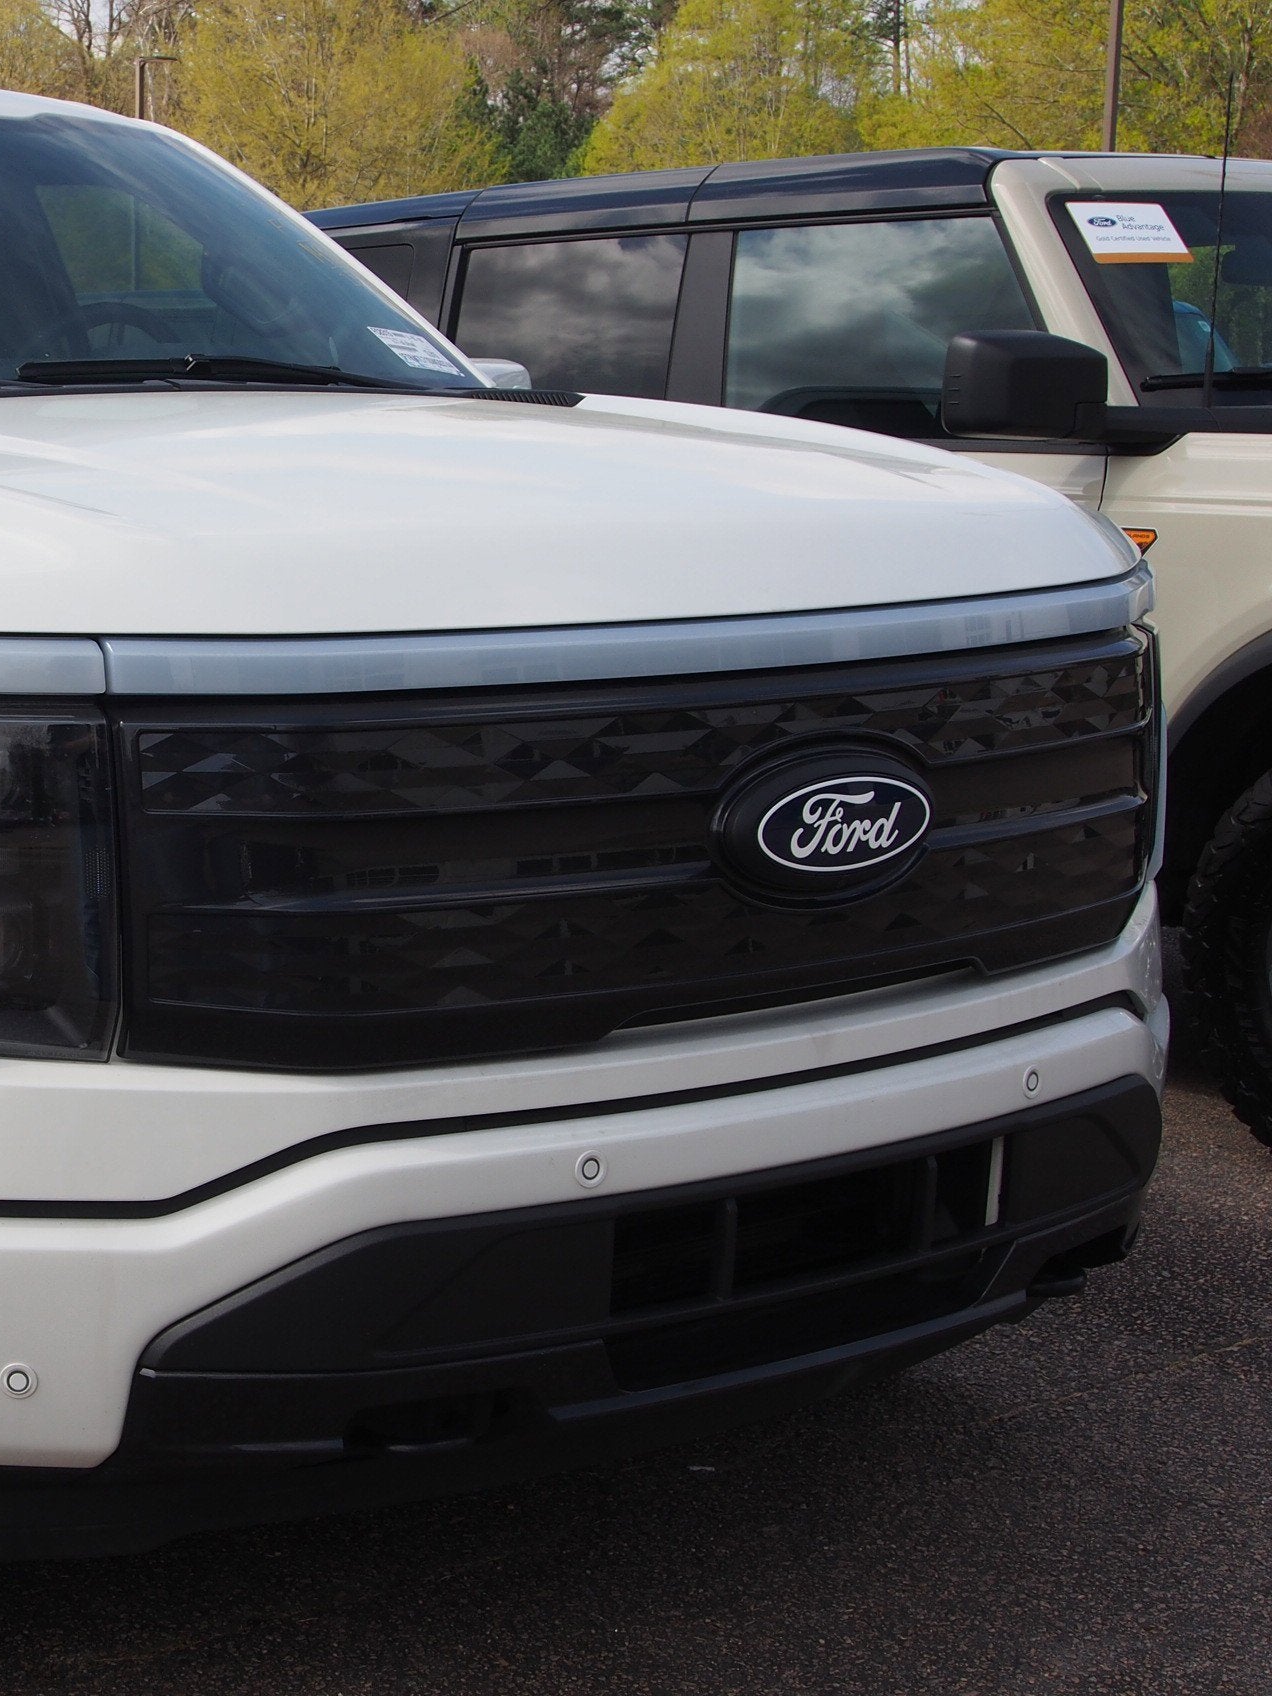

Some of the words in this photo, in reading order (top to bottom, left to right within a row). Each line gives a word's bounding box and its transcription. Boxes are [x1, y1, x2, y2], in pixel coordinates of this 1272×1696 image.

[1116, 214, 1136, 222] Blue
[1122, 223, 1165, 231] Advantage
[790, 790, 902, 859] Ford
